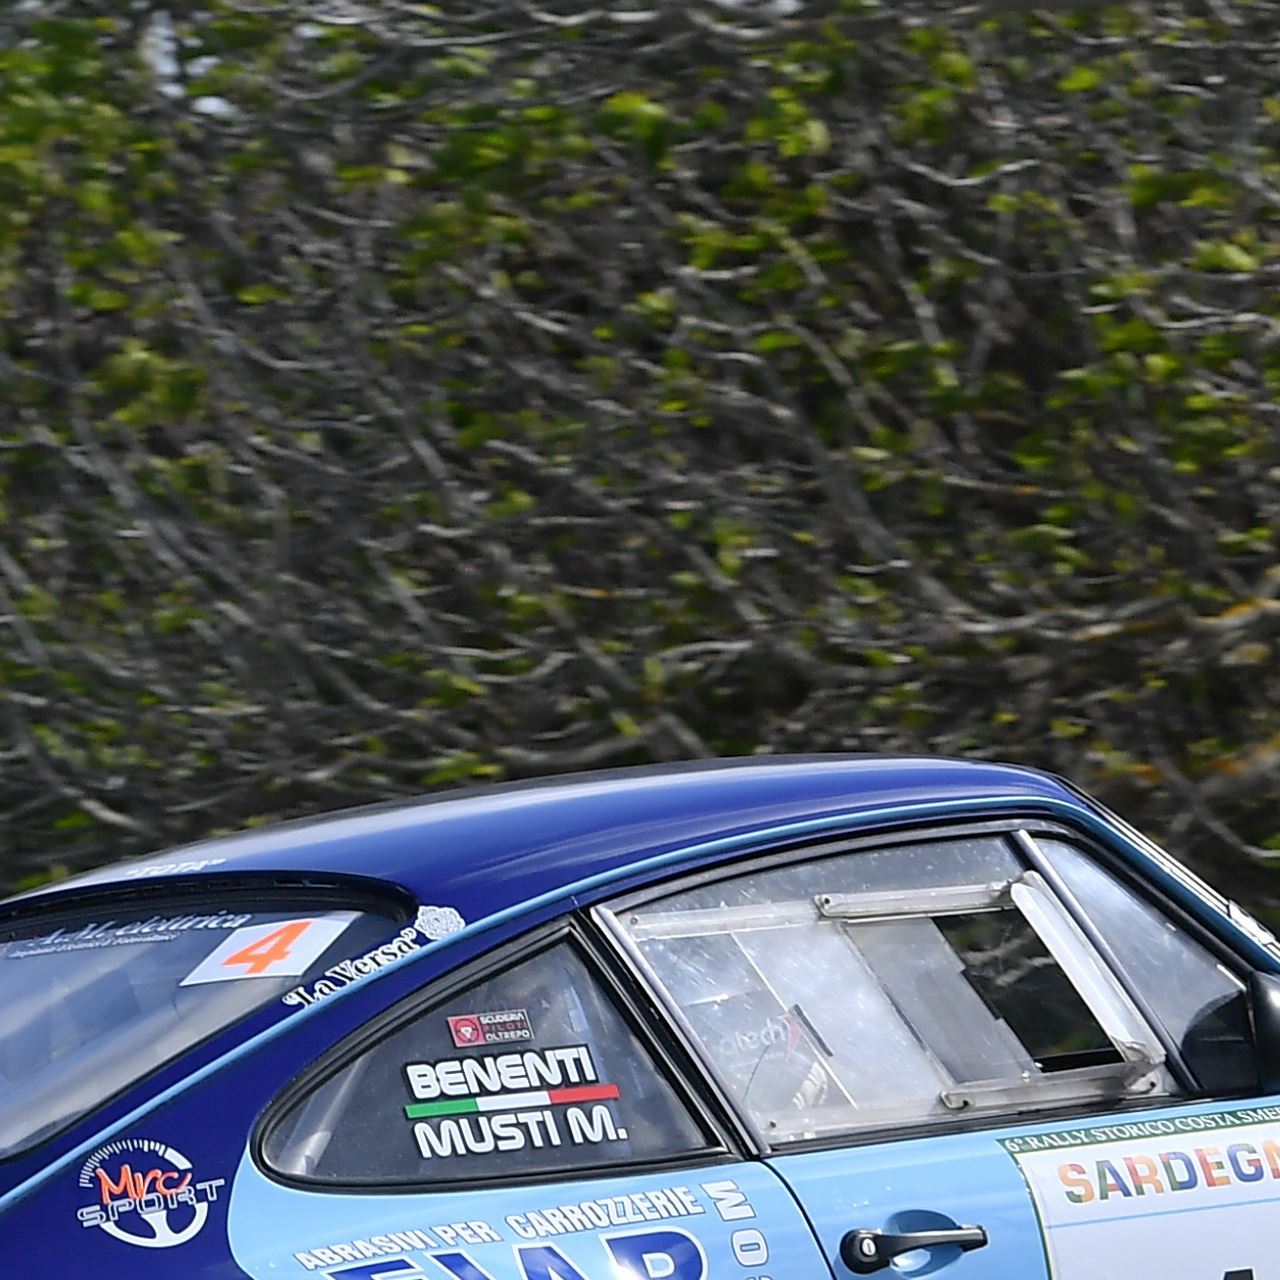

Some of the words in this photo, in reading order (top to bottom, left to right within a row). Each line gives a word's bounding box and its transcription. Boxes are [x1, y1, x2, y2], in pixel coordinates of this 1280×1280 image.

[222, 921, 312, 974] 4
[406, 1045, 597, 1099] BENENTI
[414, 1110, 562, 1159] MUSTI
[566, 1105, 628, 1144] M.
[1027, 1128, 1090, 1151] RALLY
[1092, 1119, 1175, 1140] STORICO
[1176, 1111, 1238, 1133] COSTA
[76, 1178, 226, 1229] SPORT
[293, 1227, 438, 1271] ABRASIVI
[439, 1219, 504, 1248] PER
[504, 1185, 706, 1239] CARROZZERIE
